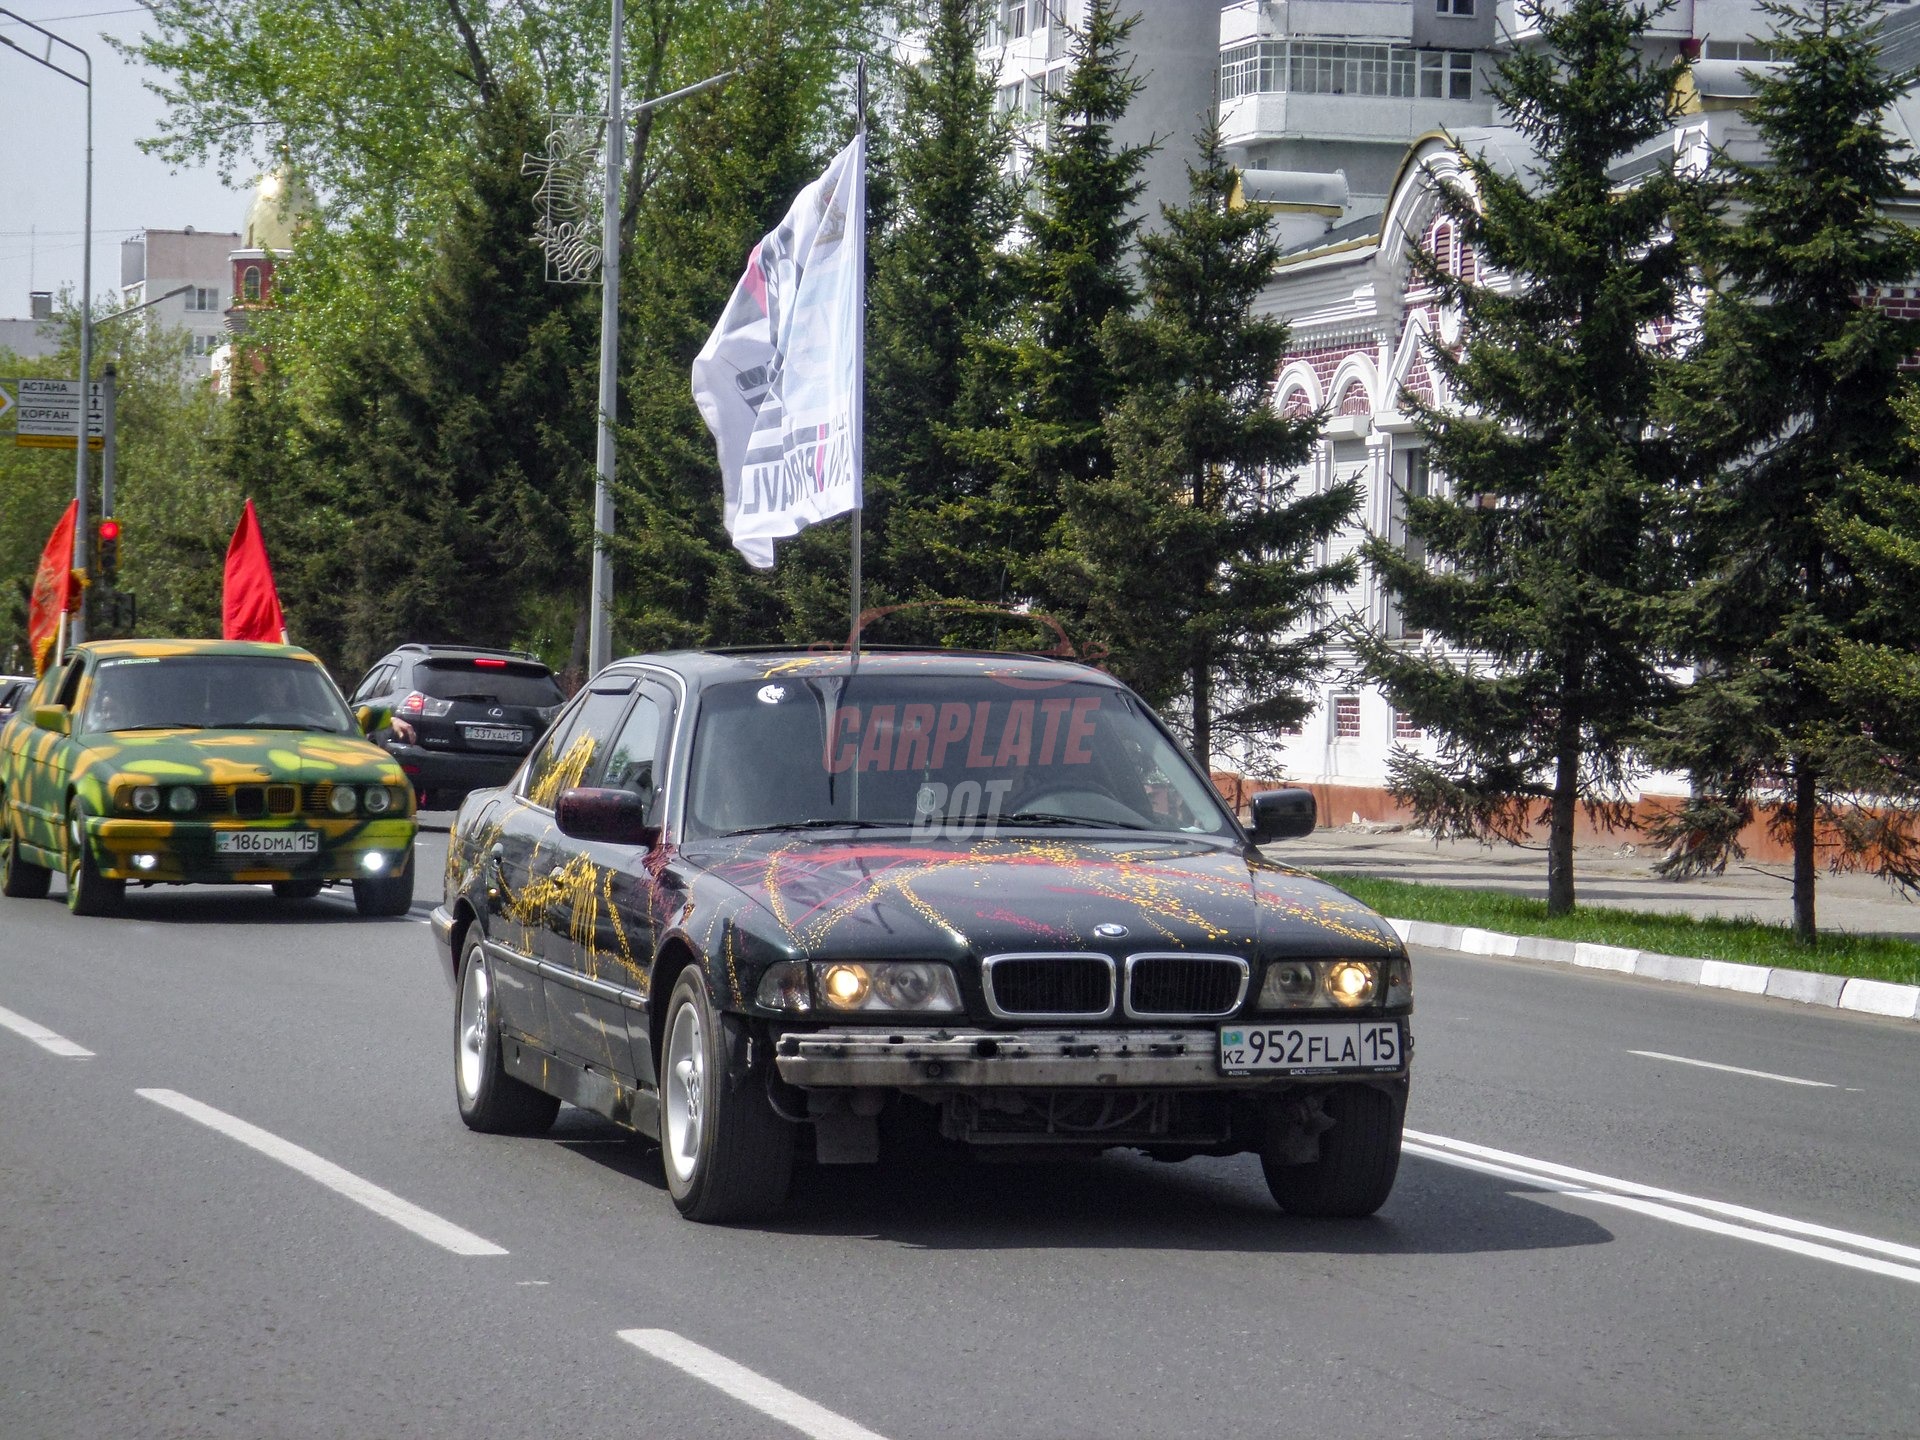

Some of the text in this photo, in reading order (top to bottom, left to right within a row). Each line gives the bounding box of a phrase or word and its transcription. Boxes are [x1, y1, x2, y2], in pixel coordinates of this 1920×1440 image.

[22, 382, 68, 392] АСТАНА
[216, 842, 229, 850] KZ
[298, 833, 317, 850] 15
[1223, 1050, 1245, 1064] KZ
[1364, 1027, 1395, 1061] 15
